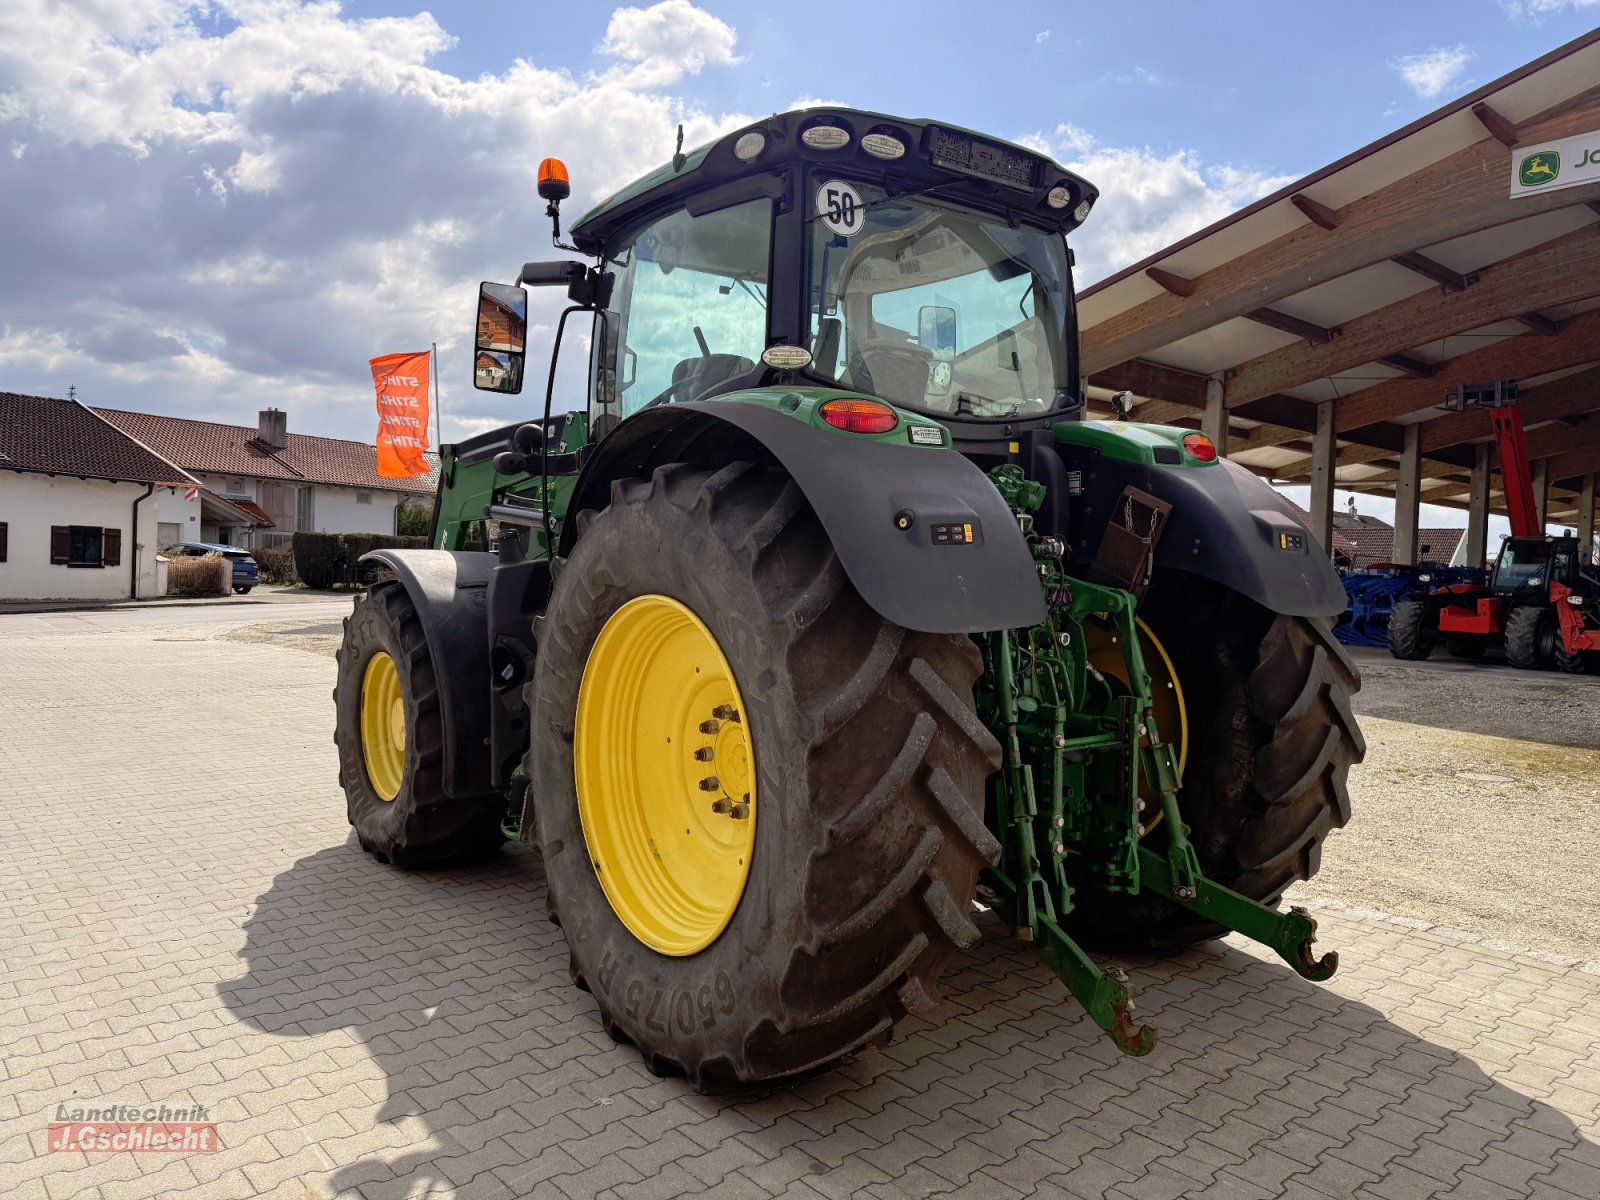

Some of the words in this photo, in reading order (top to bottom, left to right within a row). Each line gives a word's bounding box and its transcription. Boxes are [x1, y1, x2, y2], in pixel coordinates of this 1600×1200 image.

[827, 188, 855, 228] 50
[598, 950, 620, 997] R
[626, 970, 736, 1037] 650/75
